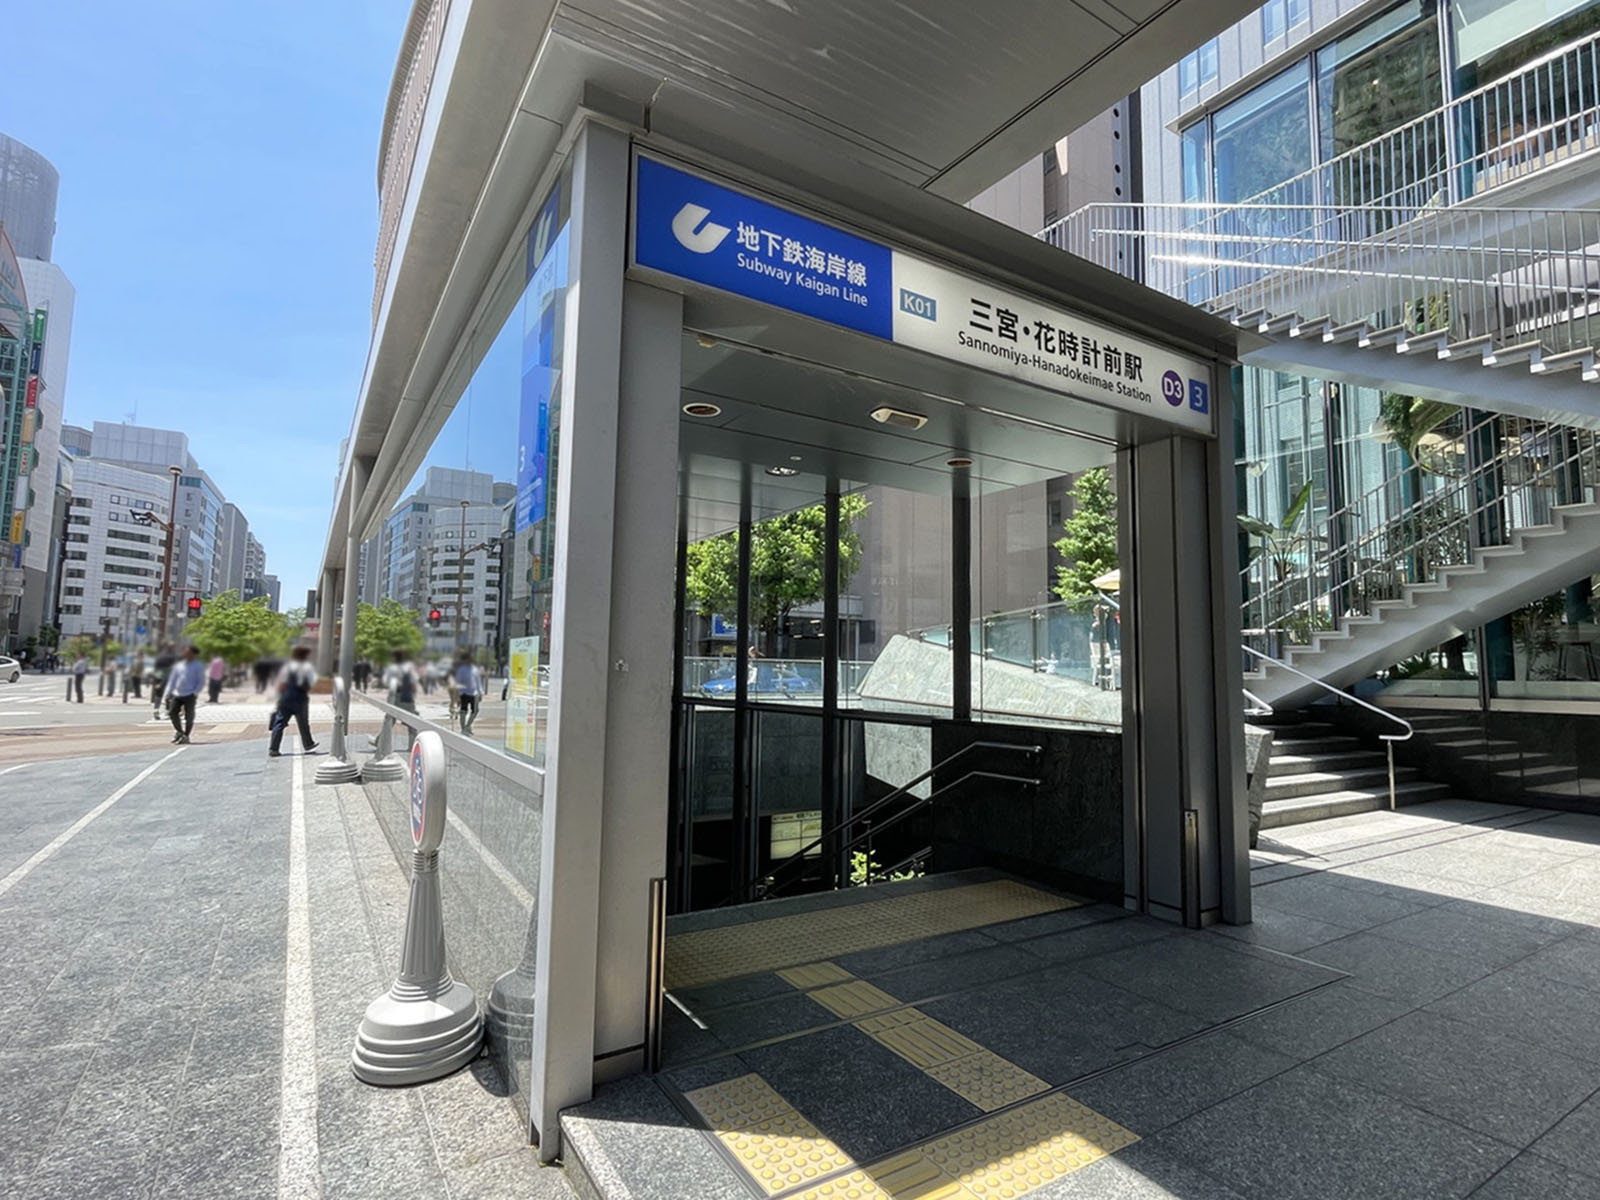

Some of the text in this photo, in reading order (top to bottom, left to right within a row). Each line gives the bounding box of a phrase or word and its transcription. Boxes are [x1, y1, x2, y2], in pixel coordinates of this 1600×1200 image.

[736, 220, 867, 287] 地下鉄海岸線
[737, 253, 868, 307] Subway Kaigan Line
[904, 293, 931, 317] K01
[969, 298, 1143, 383] 三宮・花時計前駅
[1116, 381, 1152, 403] Station
[1163, 376, 1182, 399] D3
[1194, 386, 1203, 408] 3
